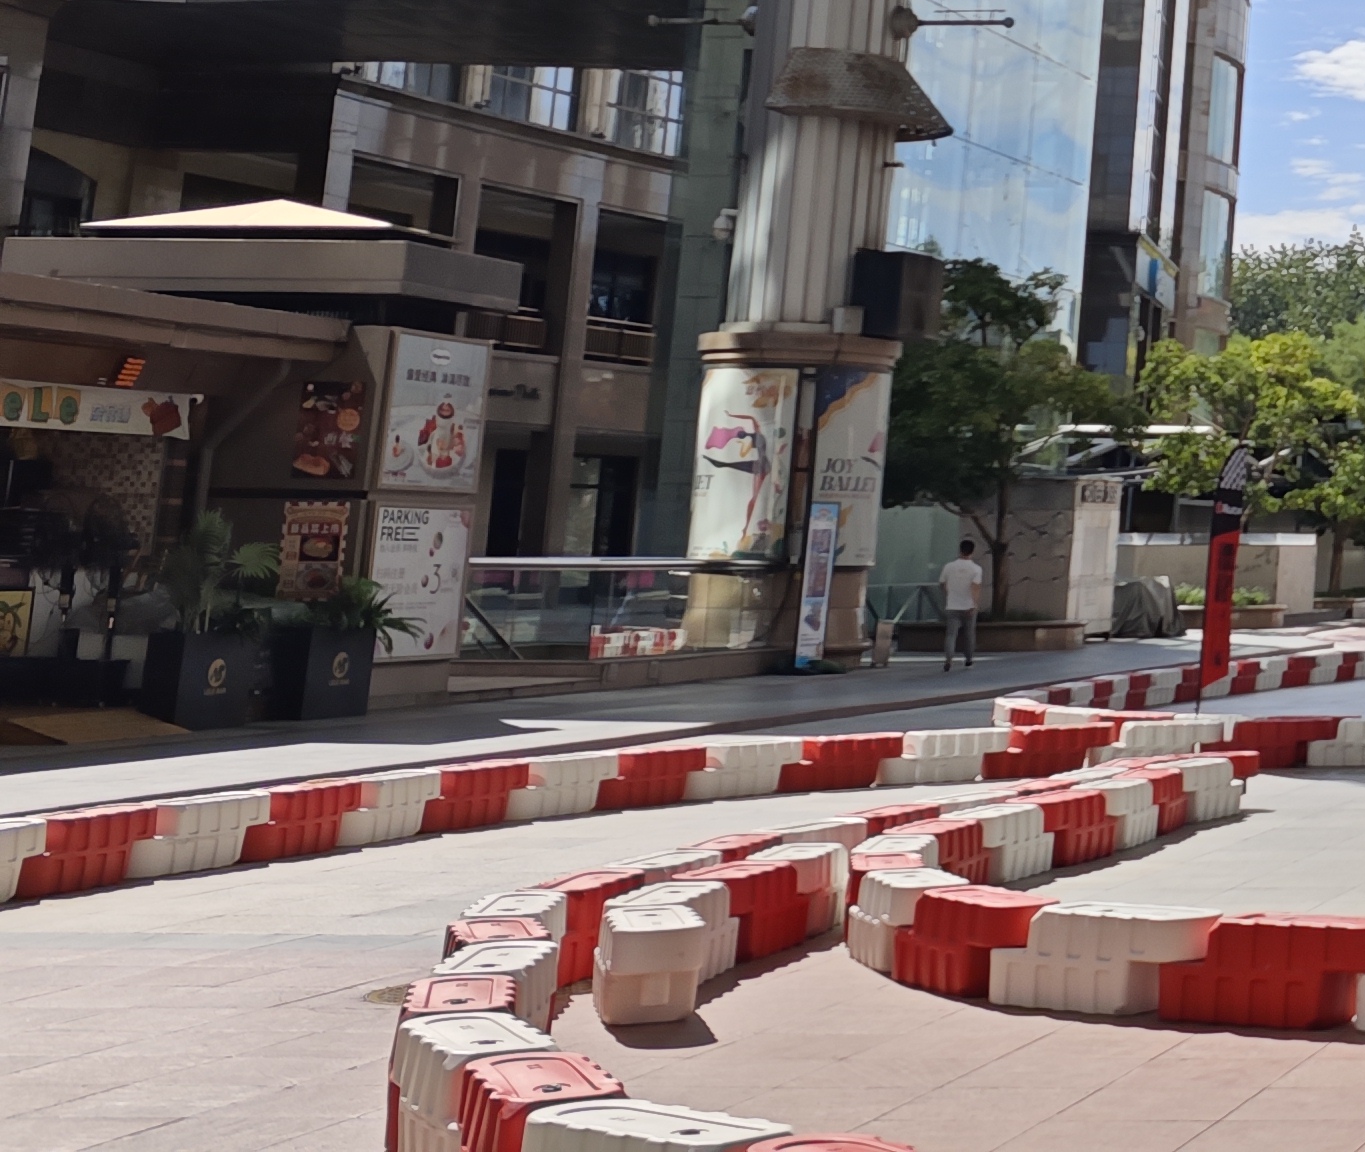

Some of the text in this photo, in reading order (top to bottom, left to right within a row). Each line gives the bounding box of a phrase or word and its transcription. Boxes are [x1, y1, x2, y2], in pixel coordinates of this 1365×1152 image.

[821, 458, 857, 474] JOY
[820, 476, 876, 492] BALLET
[382, 509, 429, 525] PARKING
[380, 527, 420, 541] FREE
[429, 563, 442, 594] 3
